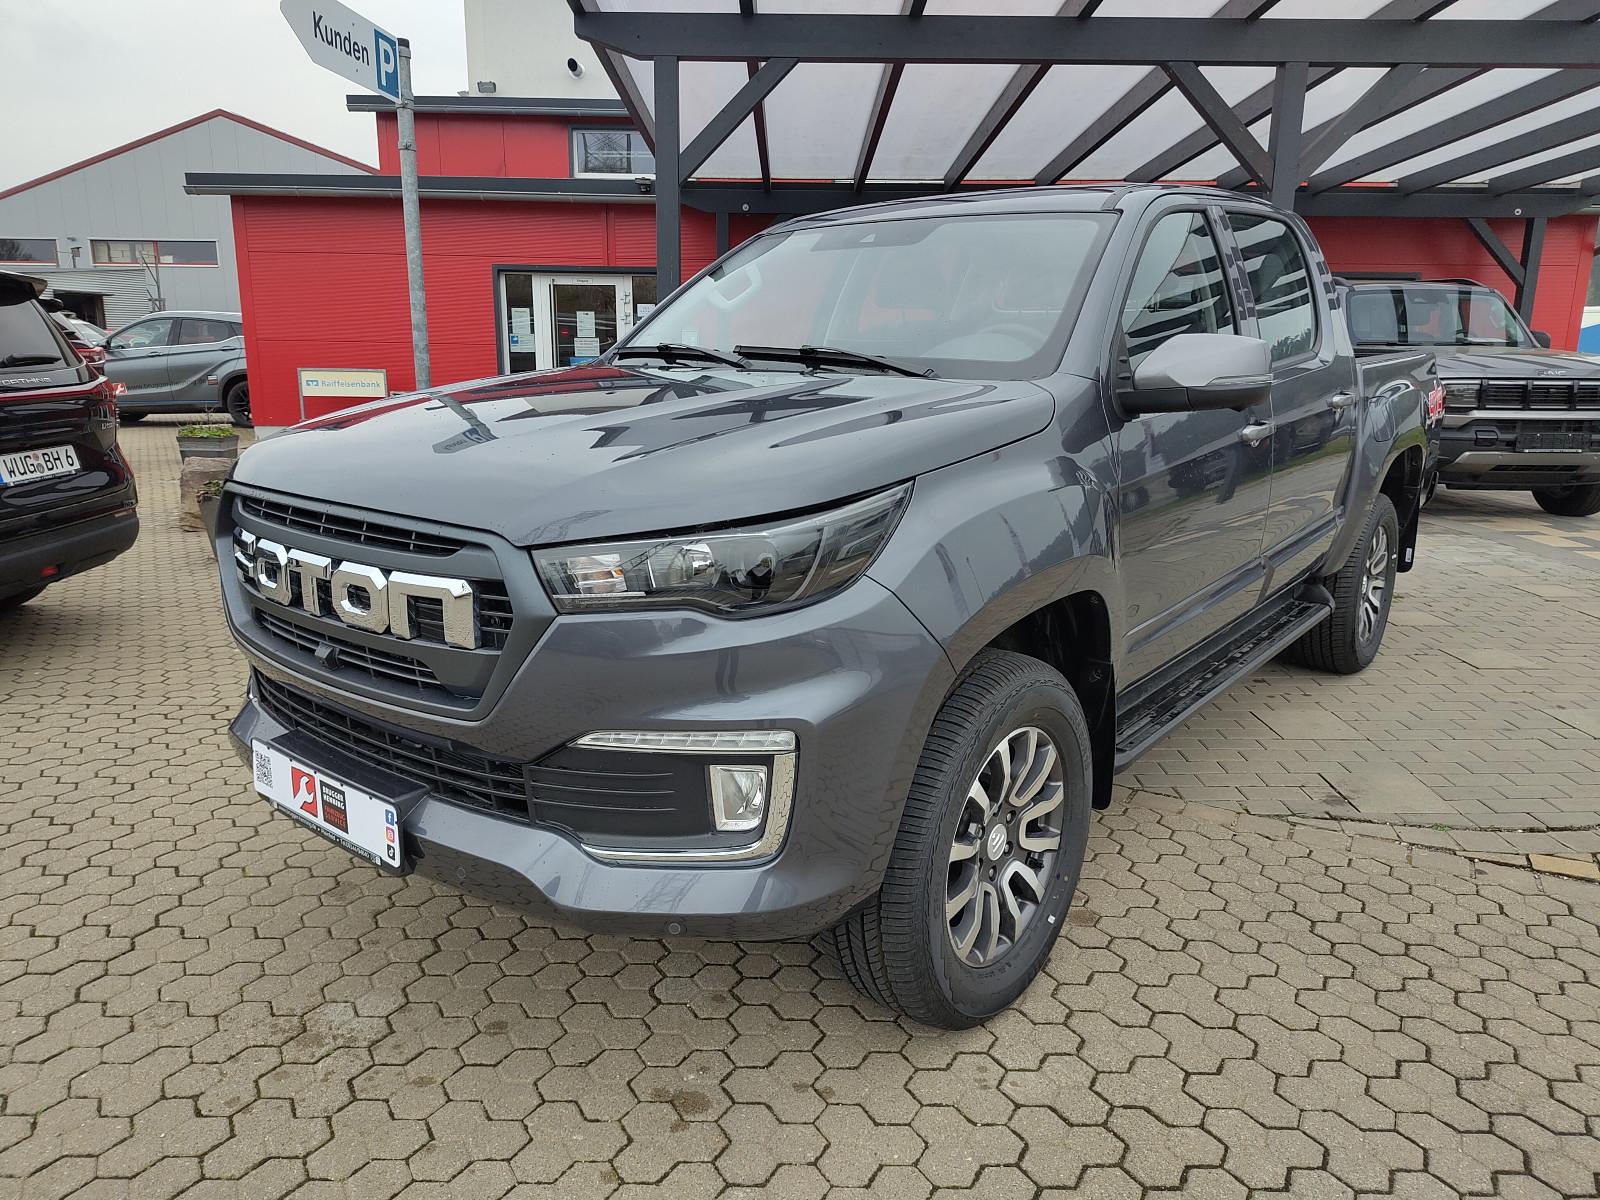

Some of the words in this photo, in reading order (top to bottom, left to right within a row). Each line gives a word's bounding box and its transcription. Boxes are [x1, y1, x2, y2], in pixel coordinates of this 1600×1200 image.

[313, 10, 370, 66] Kunden
[379, 38, 395, 87] P
[321, 380, 381, 388] Raiffeisenbank
[3, 455, 38, 479] WUG
[42, 450, 64, 471] BH
[65, 448, 75, 467] 6
[322, 785, 345, 802] BRUGGER
